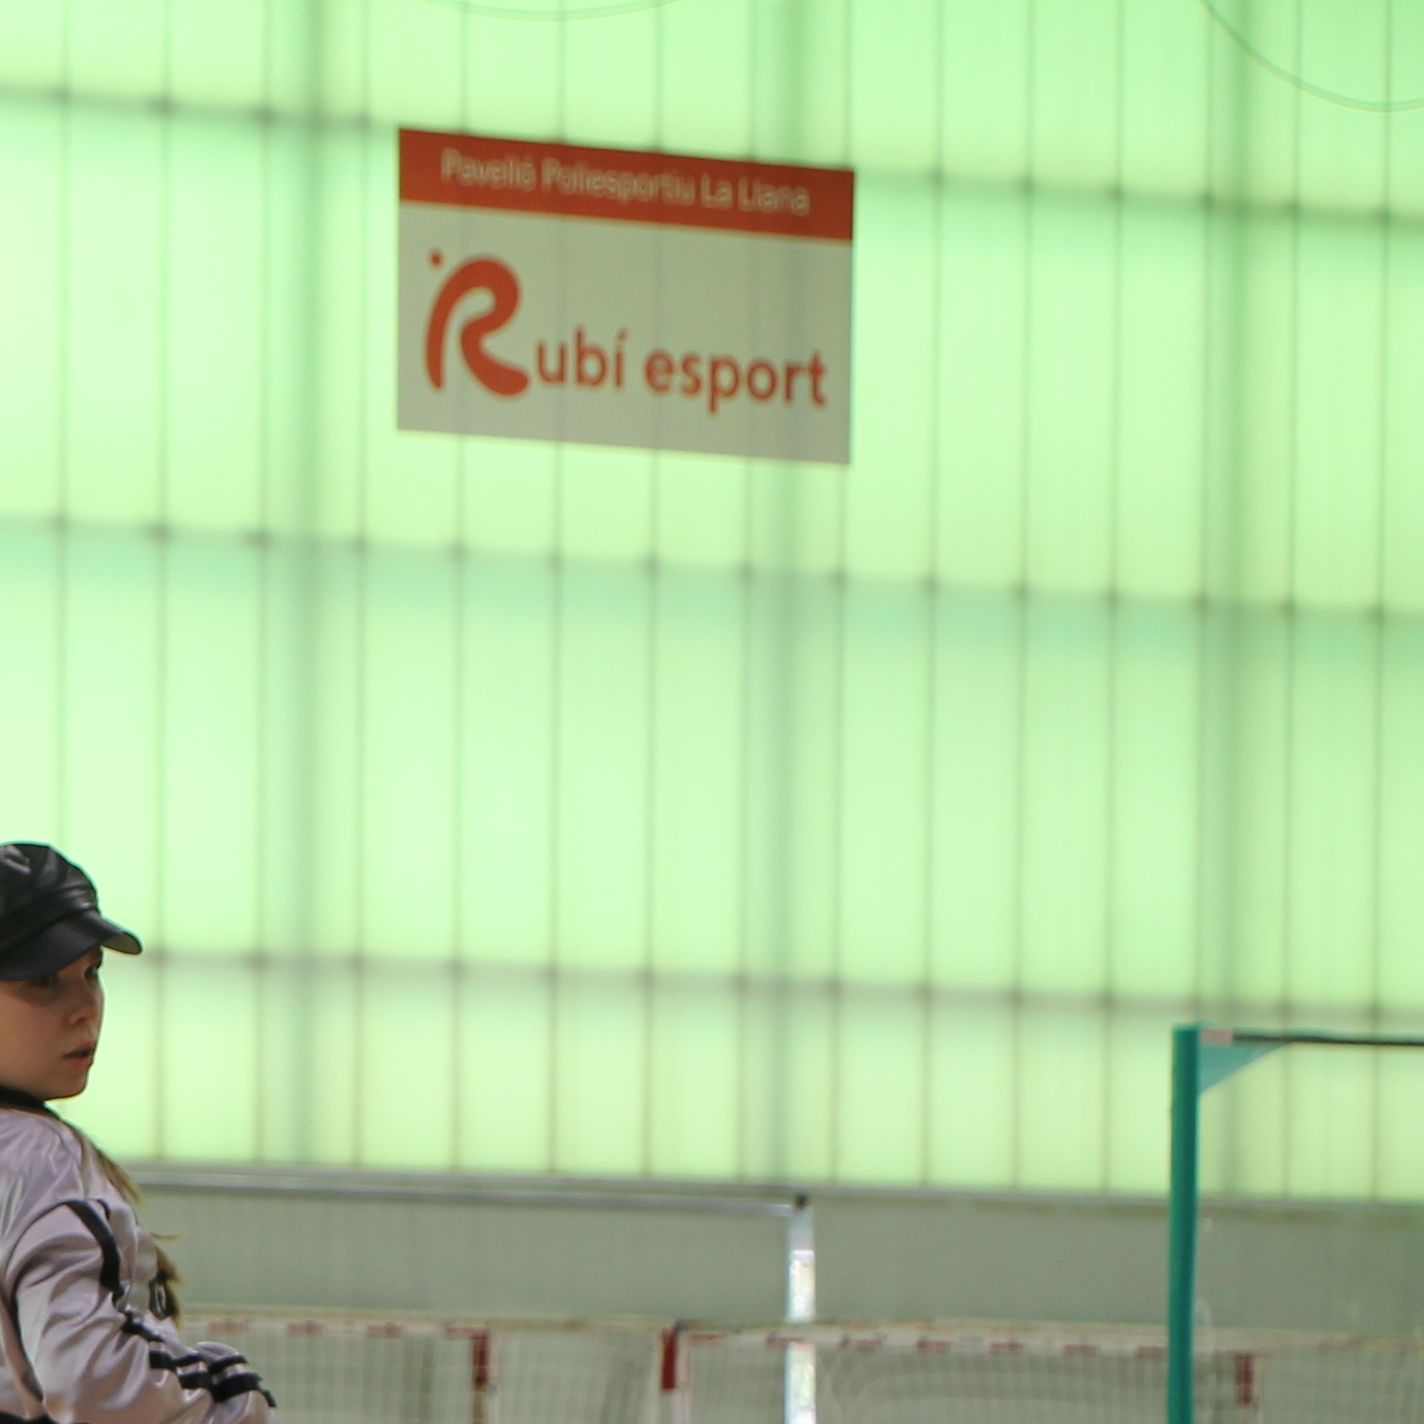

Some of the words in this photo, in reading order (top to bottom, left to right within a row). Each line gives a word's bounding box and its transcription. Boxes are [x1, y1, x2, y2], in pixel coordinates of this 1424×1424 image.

[699, 172, 733, 209] La
[738, 176, 810, 217] Llana
[643, 346, 828, 416] esport
